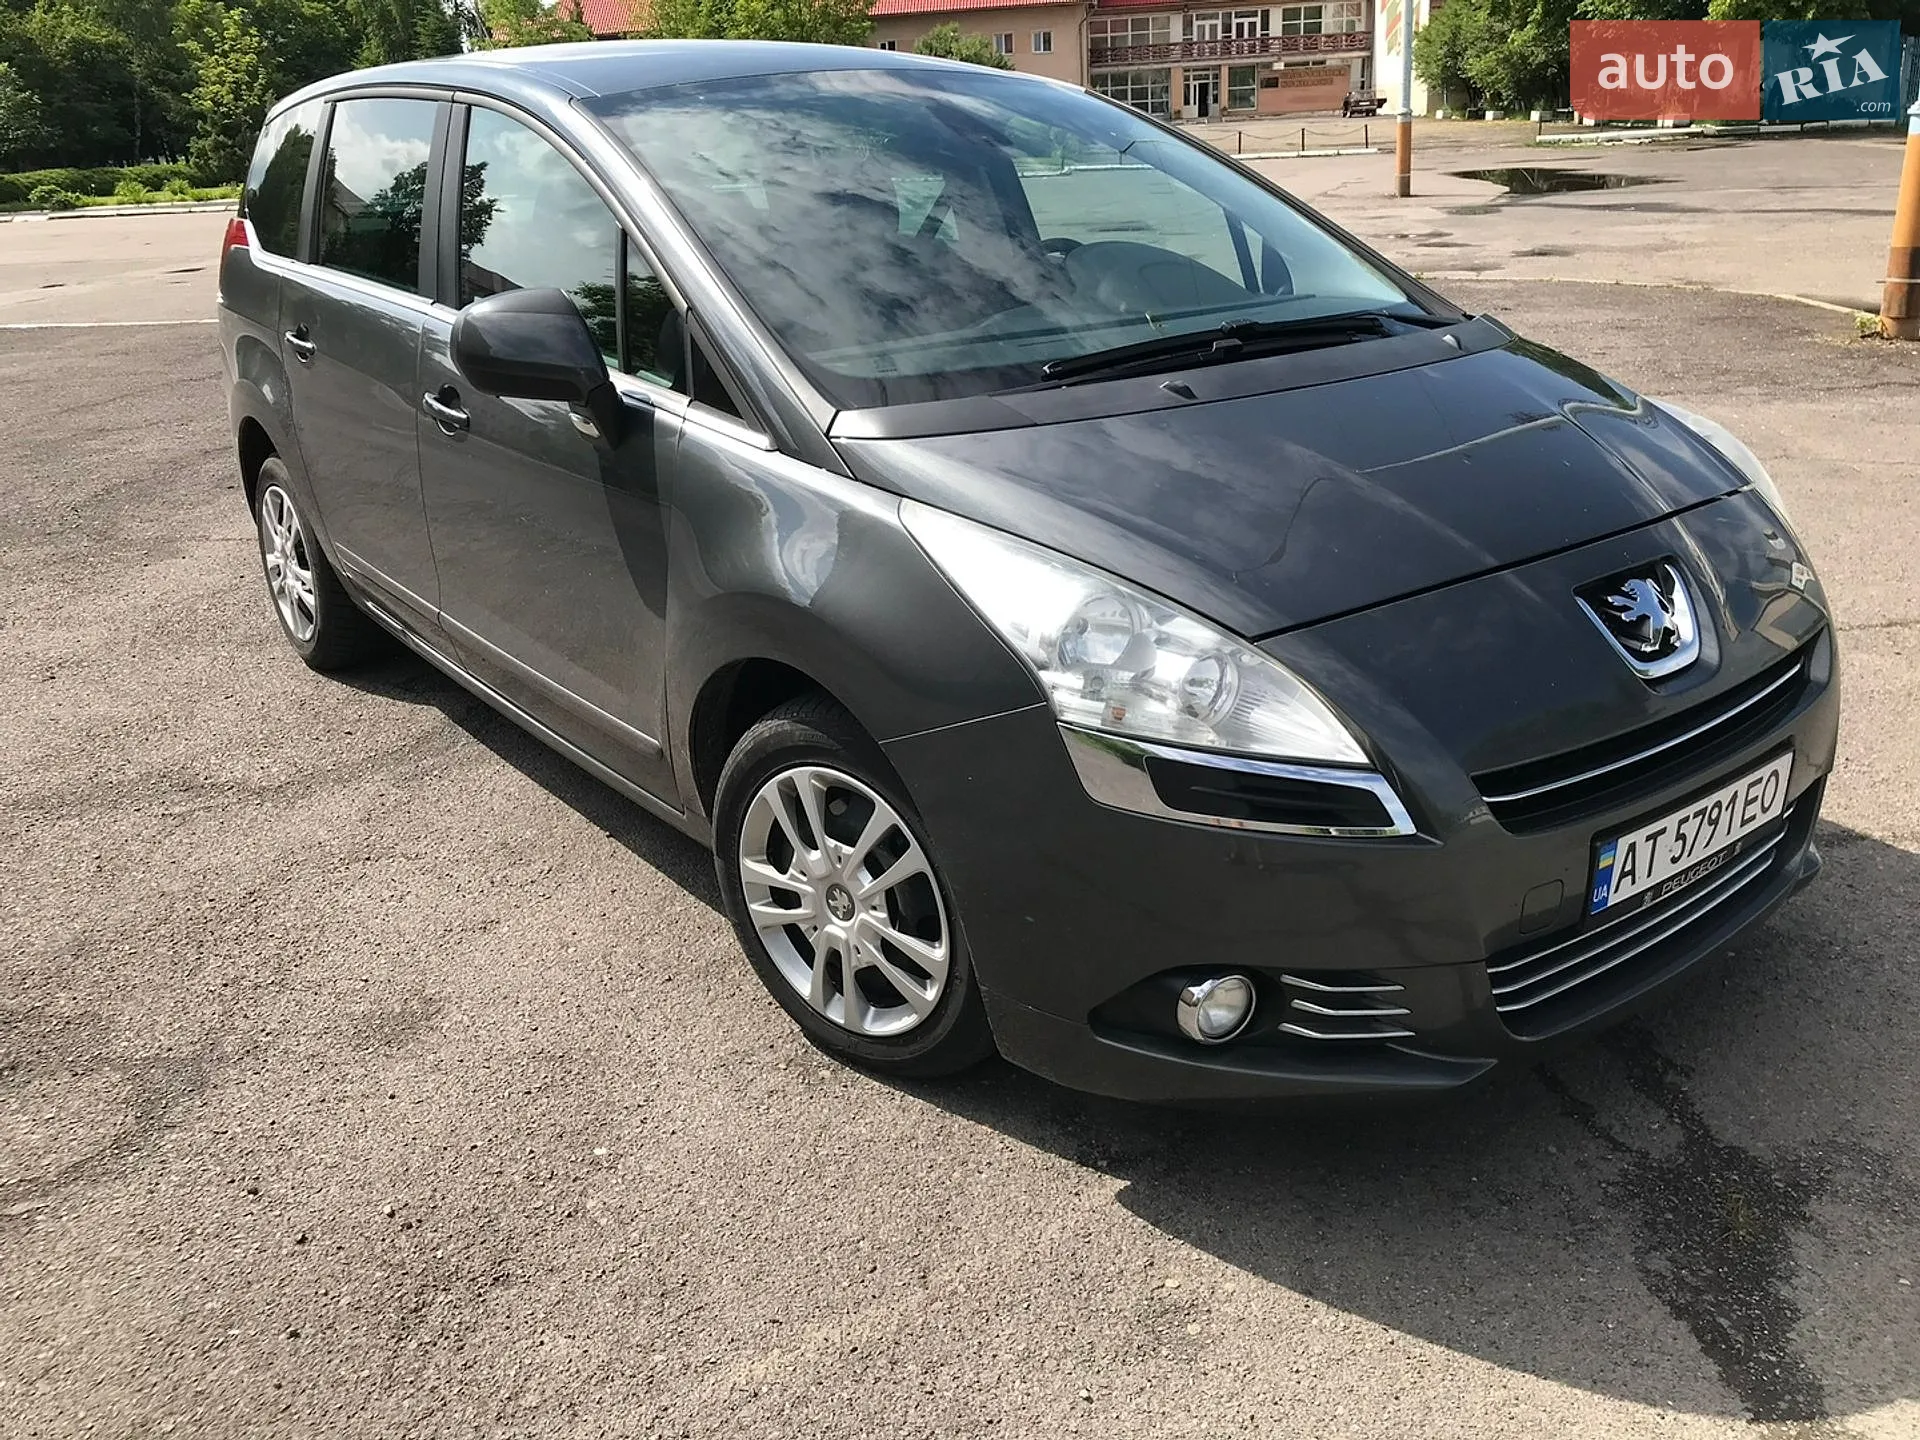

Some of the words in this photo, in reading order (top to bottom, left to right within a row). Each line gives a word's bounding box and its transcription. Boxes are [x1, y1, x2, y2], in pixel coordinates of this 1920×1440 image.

[1613, 827, 1667, 894] AT
[1670, 789, 1739, 865] 5791
[1593, 884, 1608, 902] UA
[1660, 852, 1726, 896] PEUGEOT
